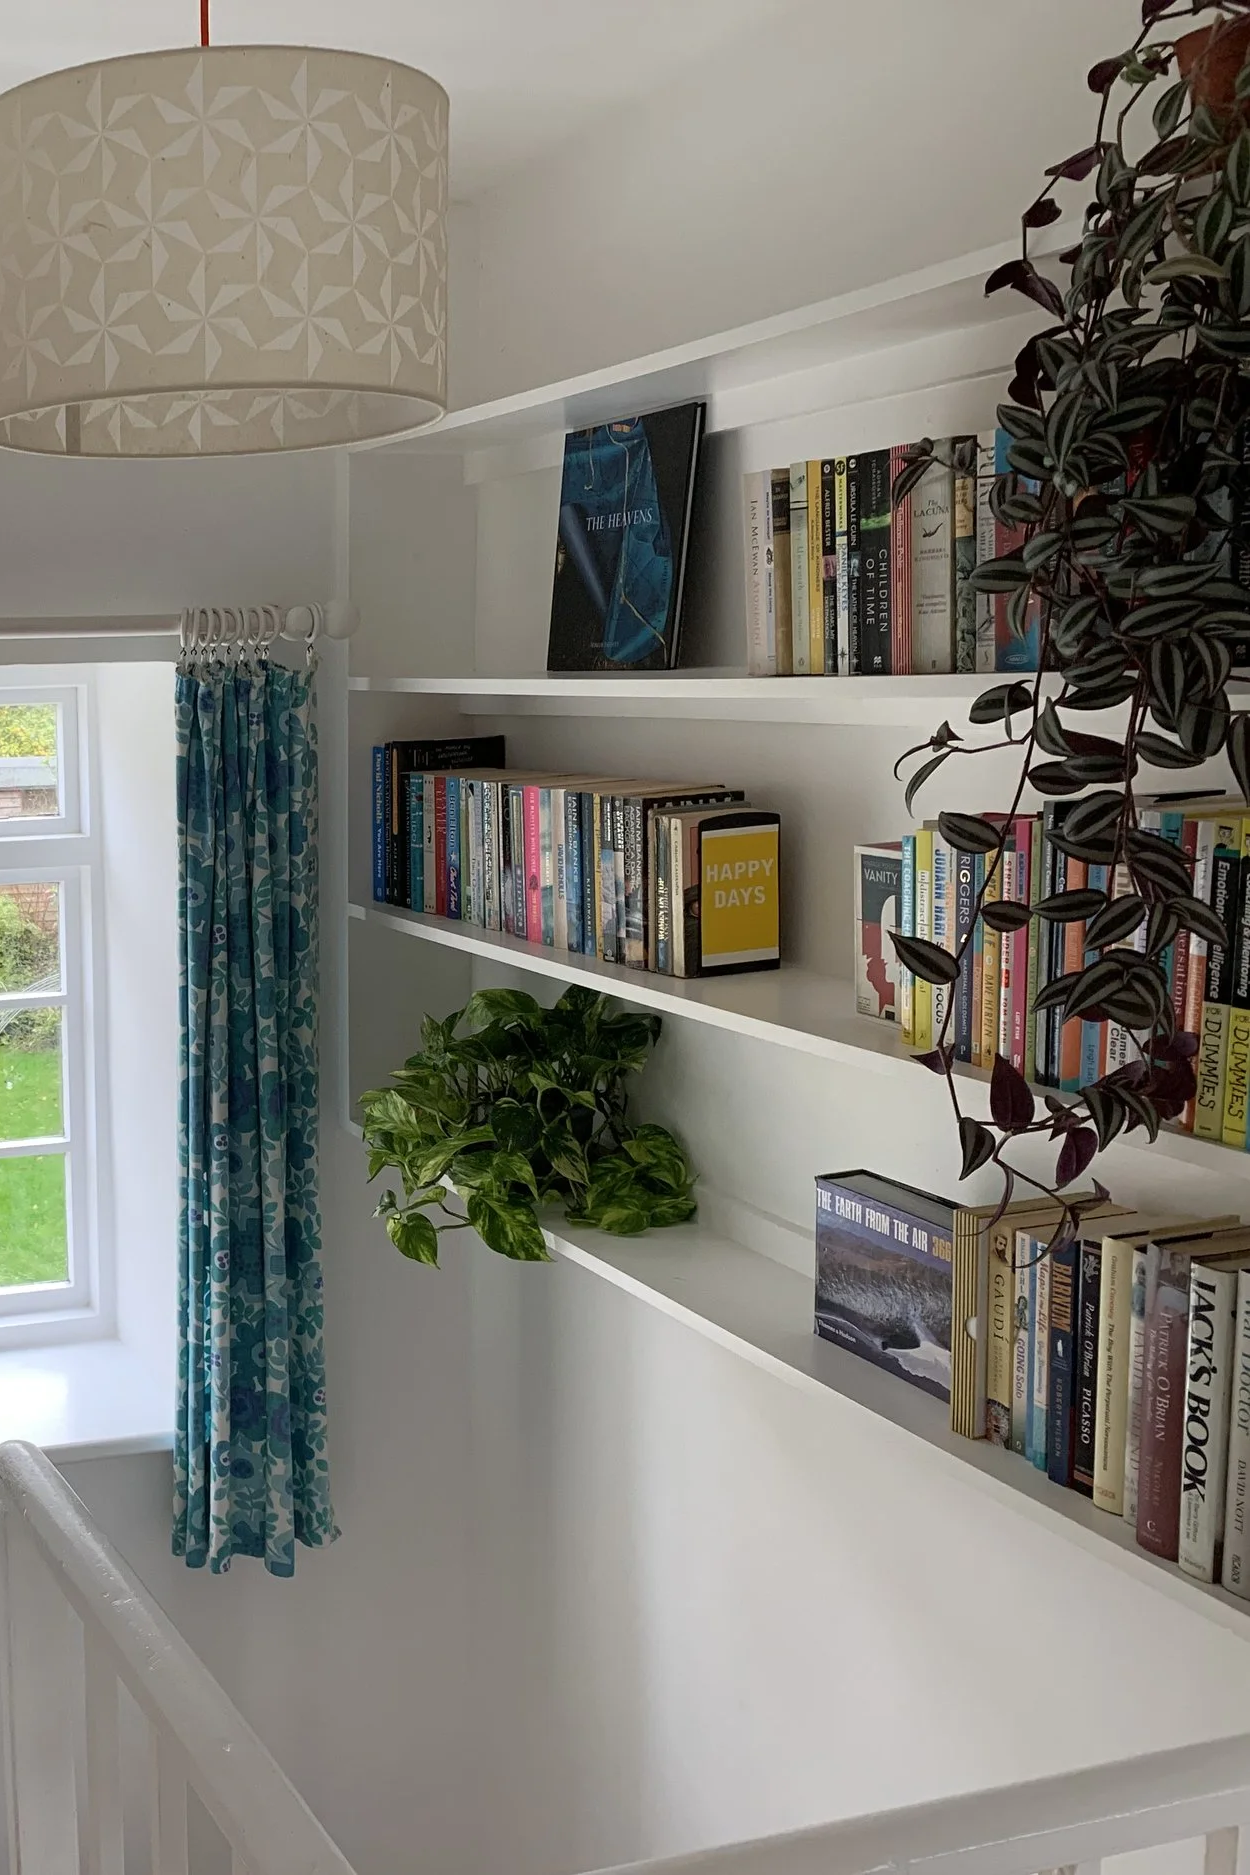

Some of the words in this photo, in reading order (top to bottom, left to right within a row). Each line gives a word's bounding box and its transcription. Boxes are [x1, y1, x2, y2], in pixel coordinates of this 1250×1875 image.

[586, 516, 605, 531] THE
[608, 508, 653, 529] HEAVENS
[750, 500, 759, 520] IAN
[913, 505, 950, 518] LACUNA
[865, 558, 875, 579] OF
[866, 587, 875, 625] TIME
[878, 549, 888, 632] CHILDREN
[375, 753, 383, 782] David
[375, 784, 383, 825] Nicholls
[705, 858, 774, 884] HAPPY
[903, 845, 911, 865] THE
[863, 868, 898, 886] VANITY
[934, 849, 946, 900] JOHANN
[714, 885, 767, 909] DAYS
[934, 905, 946, 936] HARI
[983, 974, 994, 995] DAVE
[1209, 944, 1222, 999] elligence
[1238, 936, 1250, 998] Mentoring
[935, 987, 944, 1024] FOCUS
[983, 1000, 993, 1038] KERPEN
[1206, 1006, 1222, 1016] FOR
[1234, 1014, 1250, 1024] FOR
[1110, 1027, 1120, 1062] Clear
[1118, 1027, 1127, 1066] James
[1198, 1017, 1222, 1112] DUMMIES
[1227, 1026, 1250, 1121] DUMMIES
[816, 1187, 832, 1212] THE
[835, 1195, 862, 1224] EARTH
[865, 1207, 890, 1236] FROM
[893, 1218, 909, 1245] THE
[912, 1227, 928, 1253] AIR
[1037, 1260, 1049, 1291] Maps
[993, 1274, 1009, 1343] GAUDÍ
[1051, 1259, 1072, 1334] BARNUM
[818, 1318, 836, 1333] Thames
[839, 1330, 857, 1343] Hudson
[1036, 1309, 1048, 1335] Life
[1083, 1301, 1095, 1337] Patrick
[1189, 1278, 1218, 1387] JACK'S
[1016, 1337, 1026, 1373] GOING
[1083, 1340, 1095, 1377] O'Brian
[1107, 1338, 1115, 1352] Boy
[1156, 1311, 1173, 1371] PATRICK
[1105, 1372, 1113, 1387] The
[1106, 1353, 1114, 1371] With
[1016, 1374, 1025, 1399] Solo
[1055, 1377, 1063, 1416] ROBERT
[1081, 1388, 1092, 1445] PICASSO
[1103, 1388, 1112, 1426] Perpetual
[1154, 1375, 1172, 1442] O'BRIAN
[1055, 1419, 1063, 1457] WILSON
[1183, 1391, 1211, 1503] BOOK
[1234, 1459, 1247, 1497] DAVID
[1233, 1500, 1246, 1535] NOTT
